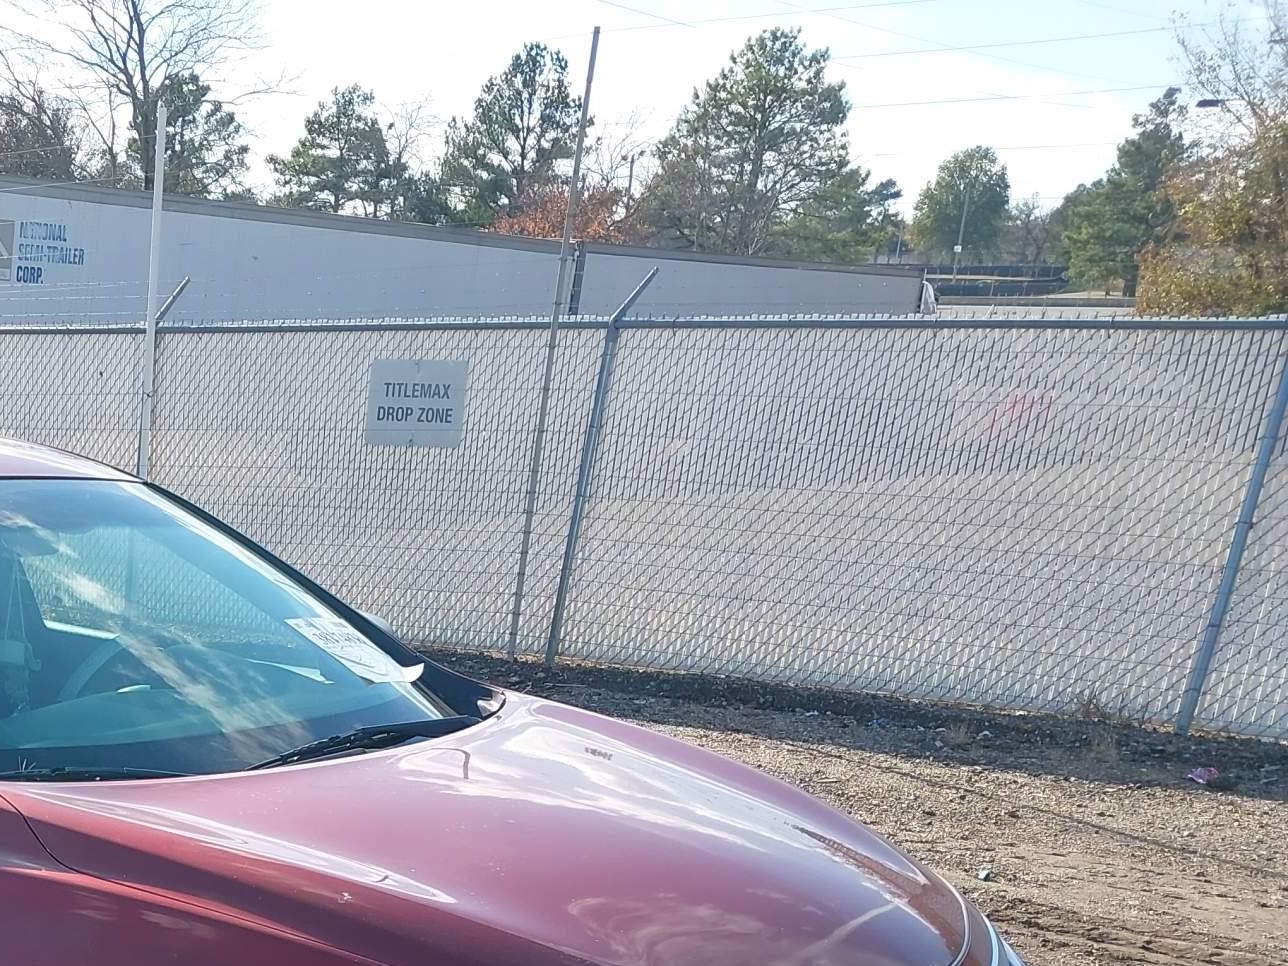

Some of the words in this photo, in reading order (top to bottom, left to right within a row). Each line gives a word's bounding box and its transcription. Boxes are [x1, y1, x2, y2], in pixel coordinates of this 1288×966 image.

[17, 243, 85, 266] SEMI-TRAILER
[15, 265, 44, 285] CORP.
[383, 382, 452, 400] TITLEMAX
[376, 405, 414, 422] DROP
[416, 407, 454, 424] ZONE
